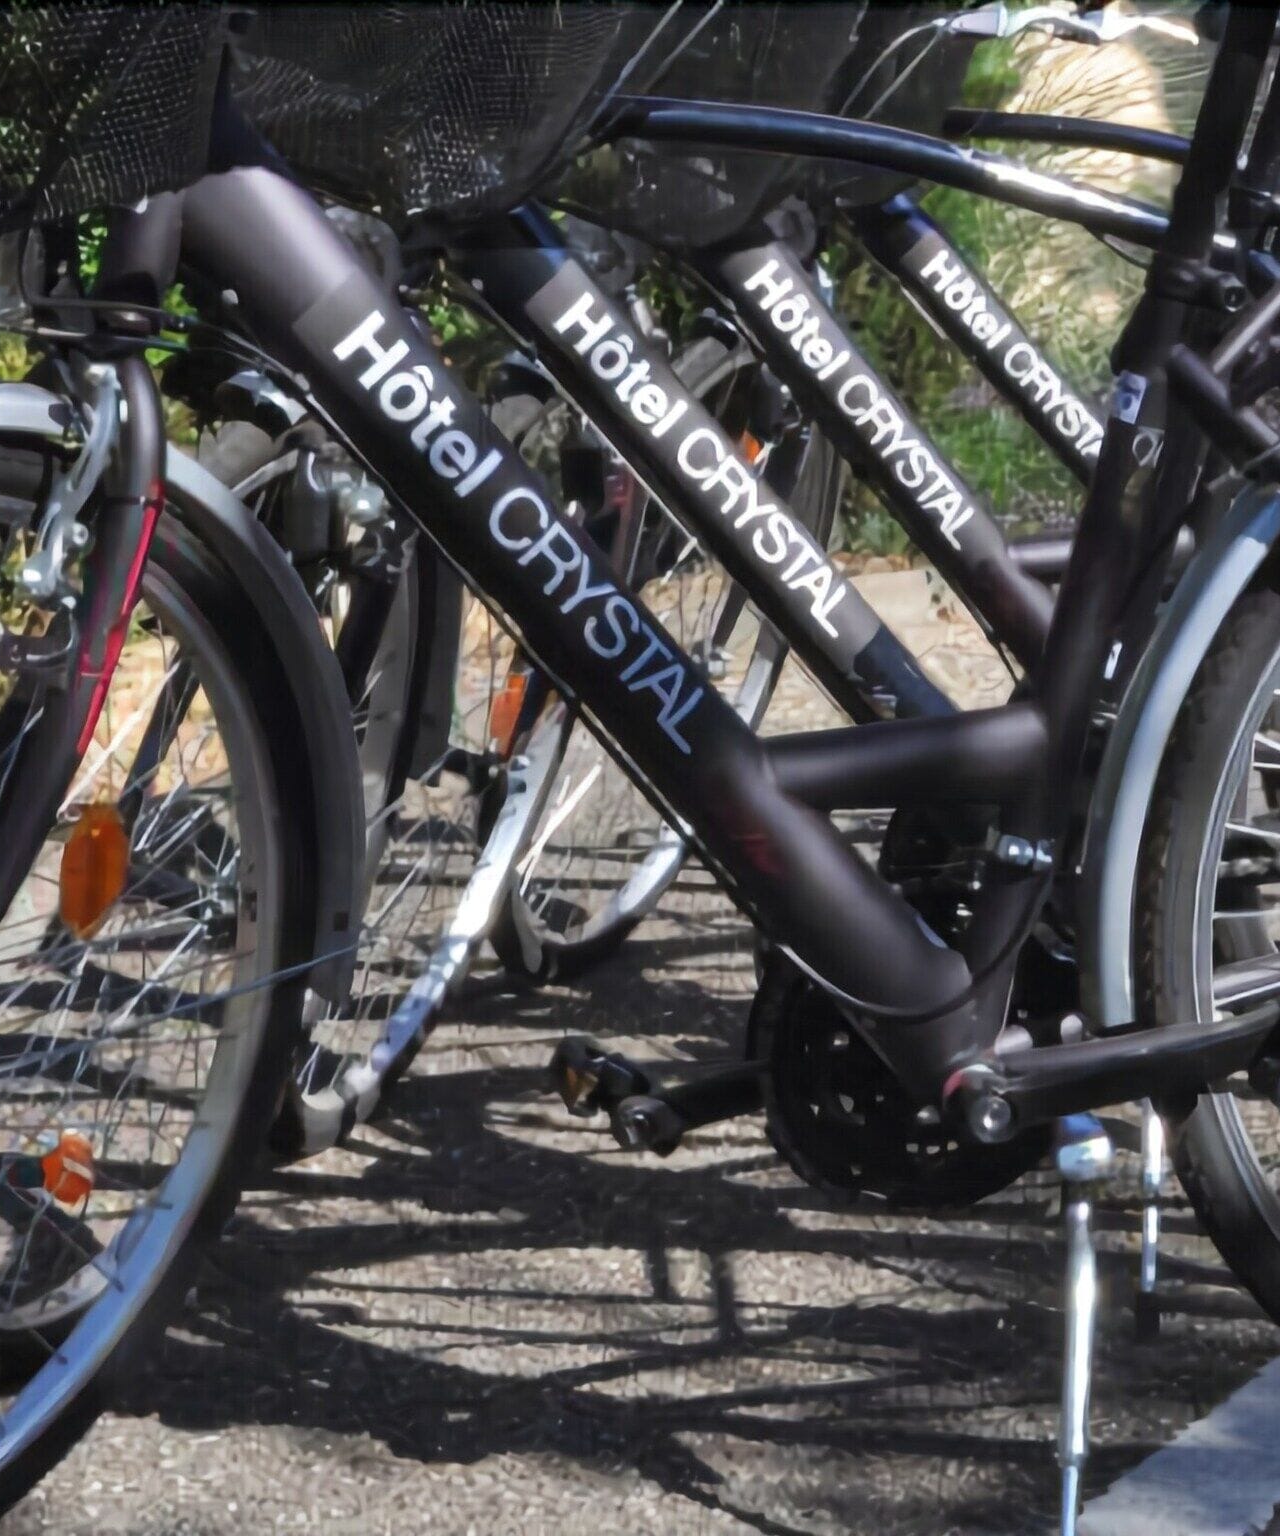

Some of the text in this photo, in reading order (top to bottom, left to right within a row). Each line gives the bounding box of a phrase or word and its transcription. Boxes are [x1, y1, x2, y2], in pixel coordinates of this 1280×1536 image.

[554, 292, 861, 638] Hôtel CRYSTAL
[744, 260, 976, 550] Hôtel CRYSTAL
[920, 250, 1105, 456] Hôtel CRYST
[333, 310, 711, 755] Hôtel CRYSTAL
